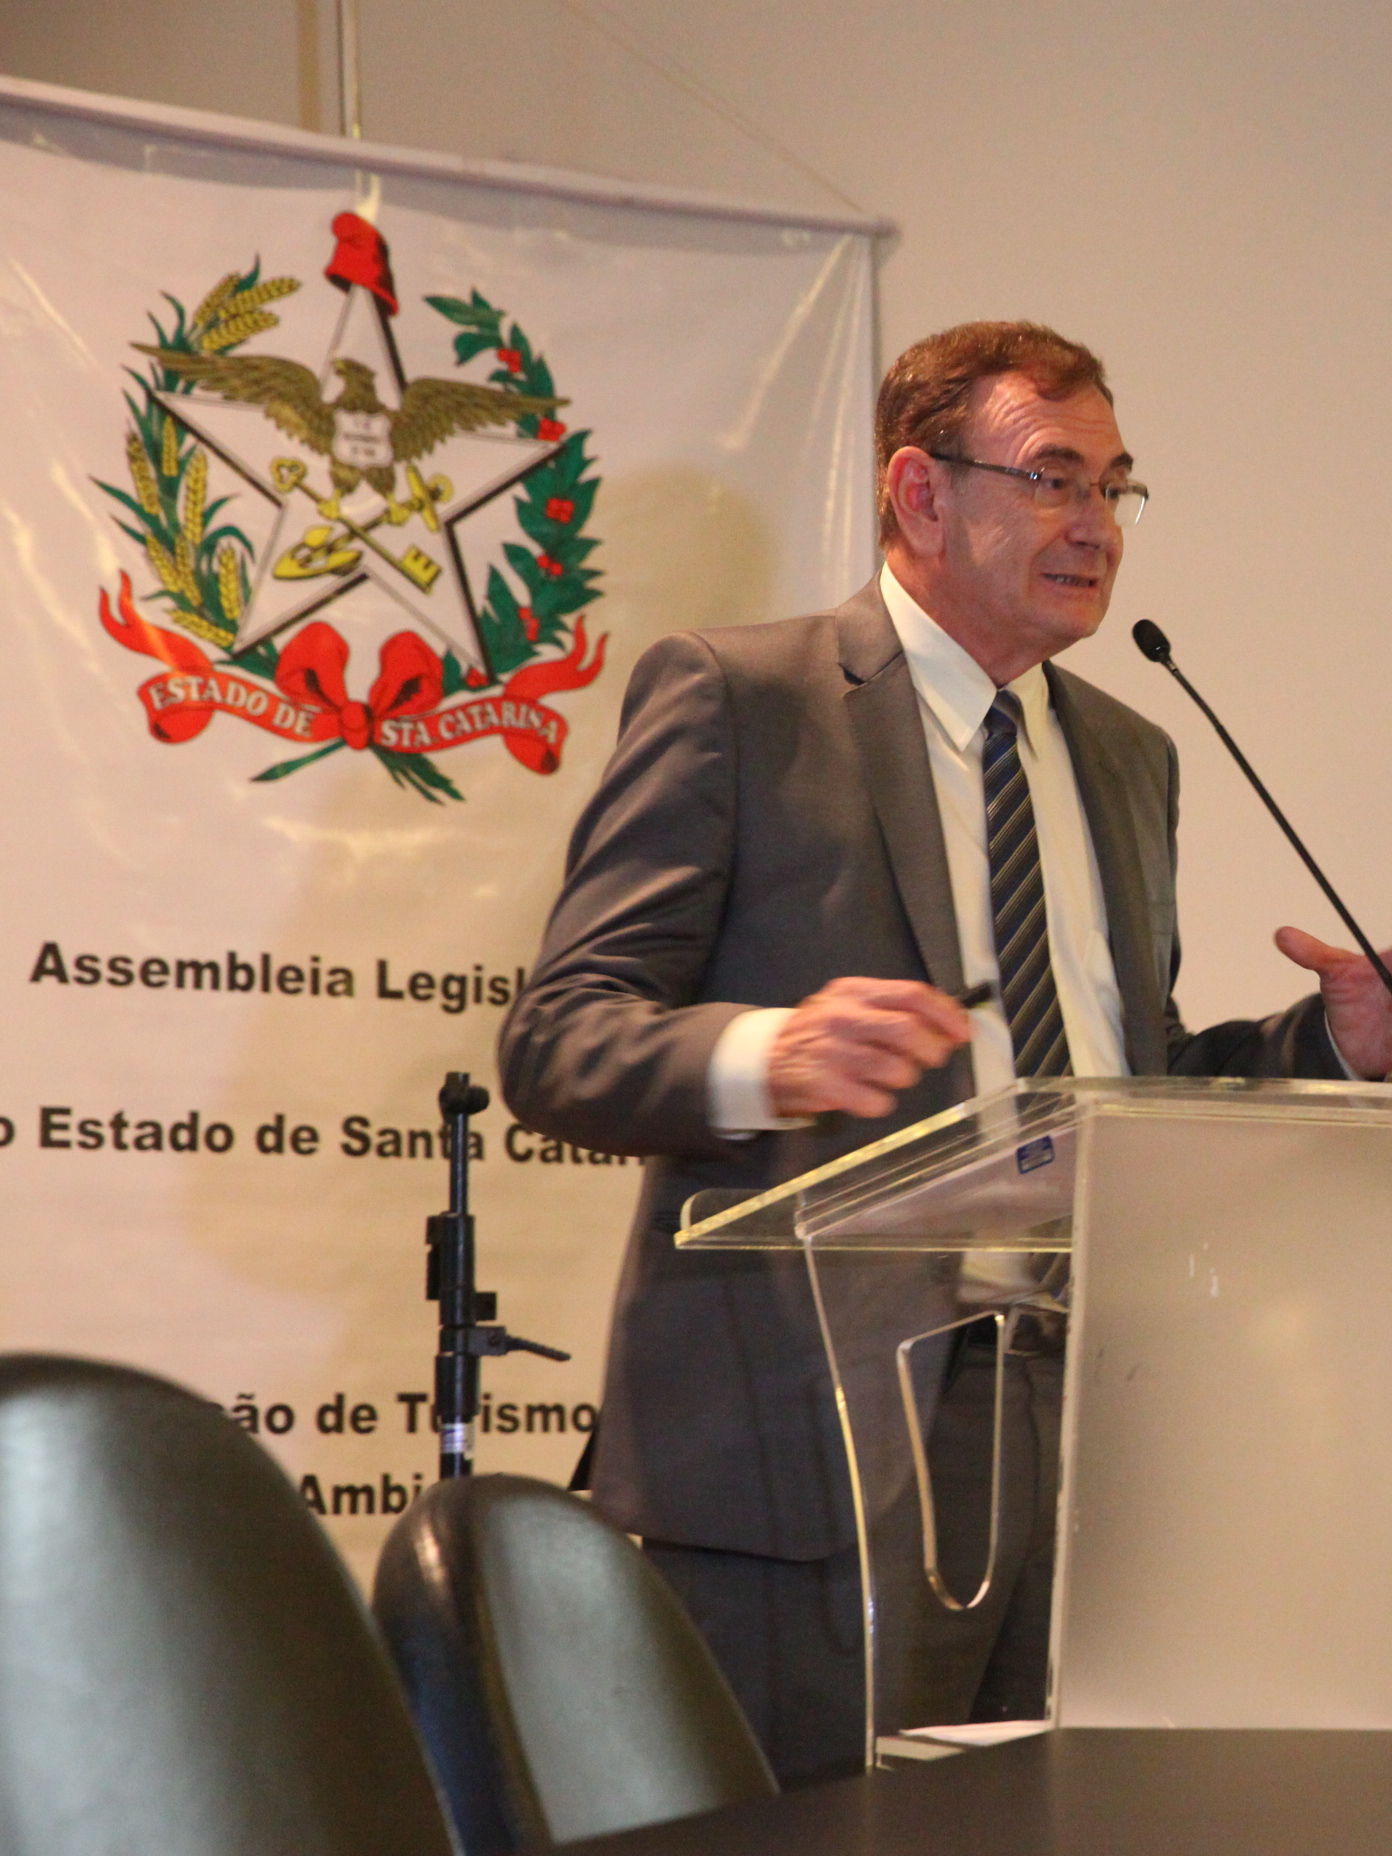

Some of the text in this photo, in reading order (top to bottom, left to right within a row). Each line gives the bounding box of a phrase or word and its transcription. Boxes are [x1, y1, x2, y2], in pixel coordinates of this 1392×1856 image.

[149, 676, 315, 737] ESTADO DE
[439, 701, 558, 744] CATARINA
[29, 941, 354, 998] Assembleia
[40, 1106, 235, 1153] Estado
[256, 1113, 319, 1156] de
[316, 1394, 377, 1435] de
